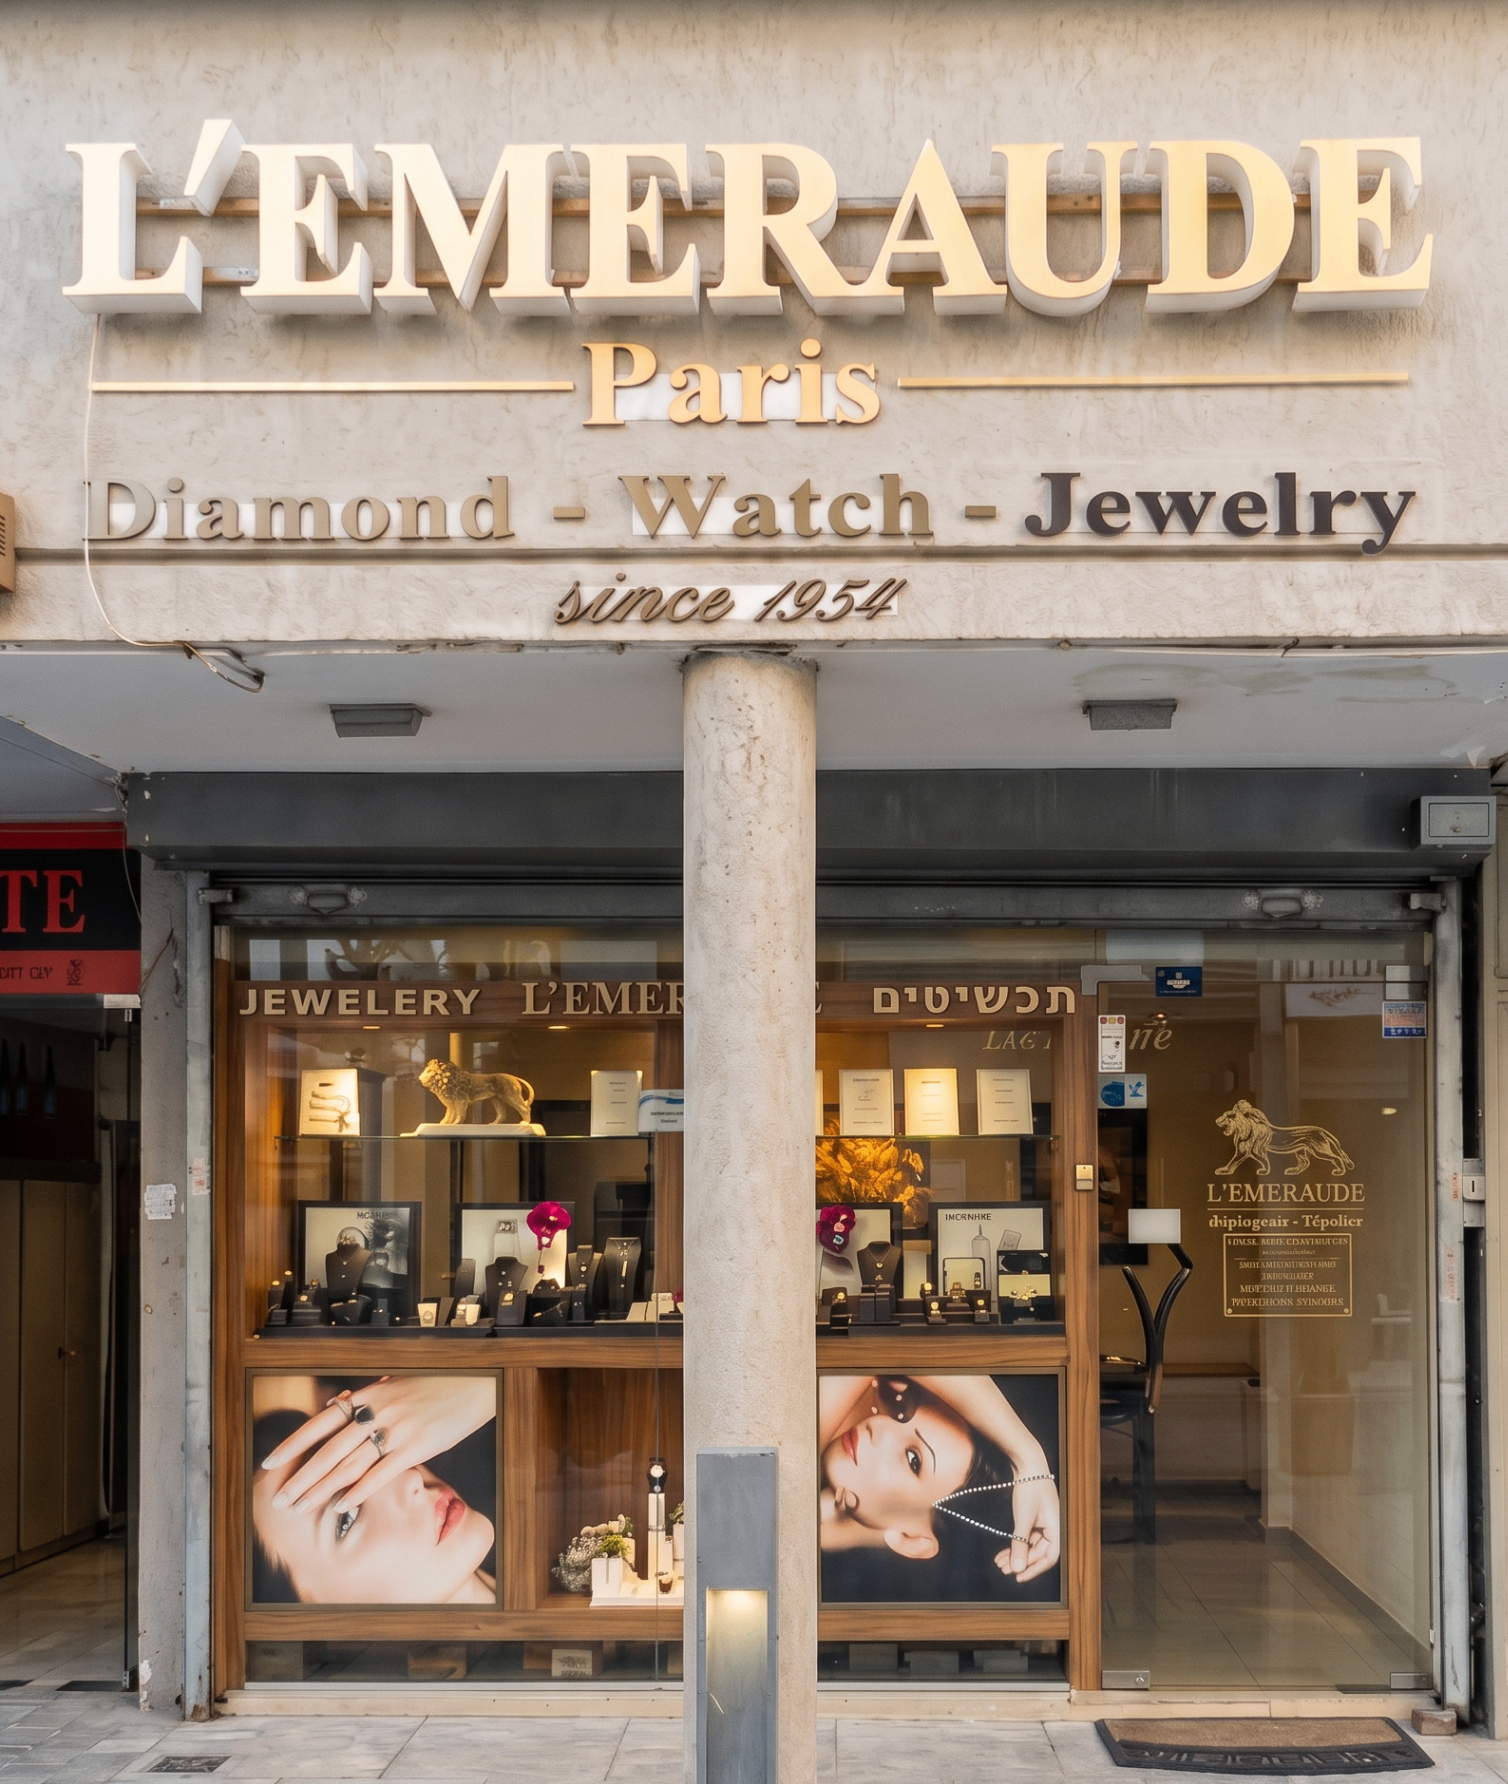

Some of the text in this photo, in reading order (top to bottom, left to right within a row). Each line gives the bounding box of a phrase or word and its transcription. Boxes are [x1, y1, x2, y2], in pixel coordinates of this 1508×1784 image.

[62, 117, 1434, 317] L'EMERAUDE
[581, 338, 881, 427] Paris
[83, 475, 514, 542] Diamond
[618, 473, 933, 539] Watch
[1025, 471, 1417, 556] Jewelry
[553, 572, 908, 624] since 1954
[239, 988, 482, 1016] JEWELERY
[521, 981, 822, 1015] L'EMER
[872, 985, 1077, 1015] תכשיטים
[1206, 1183, 1366, 1203] L'EMERAUDE
